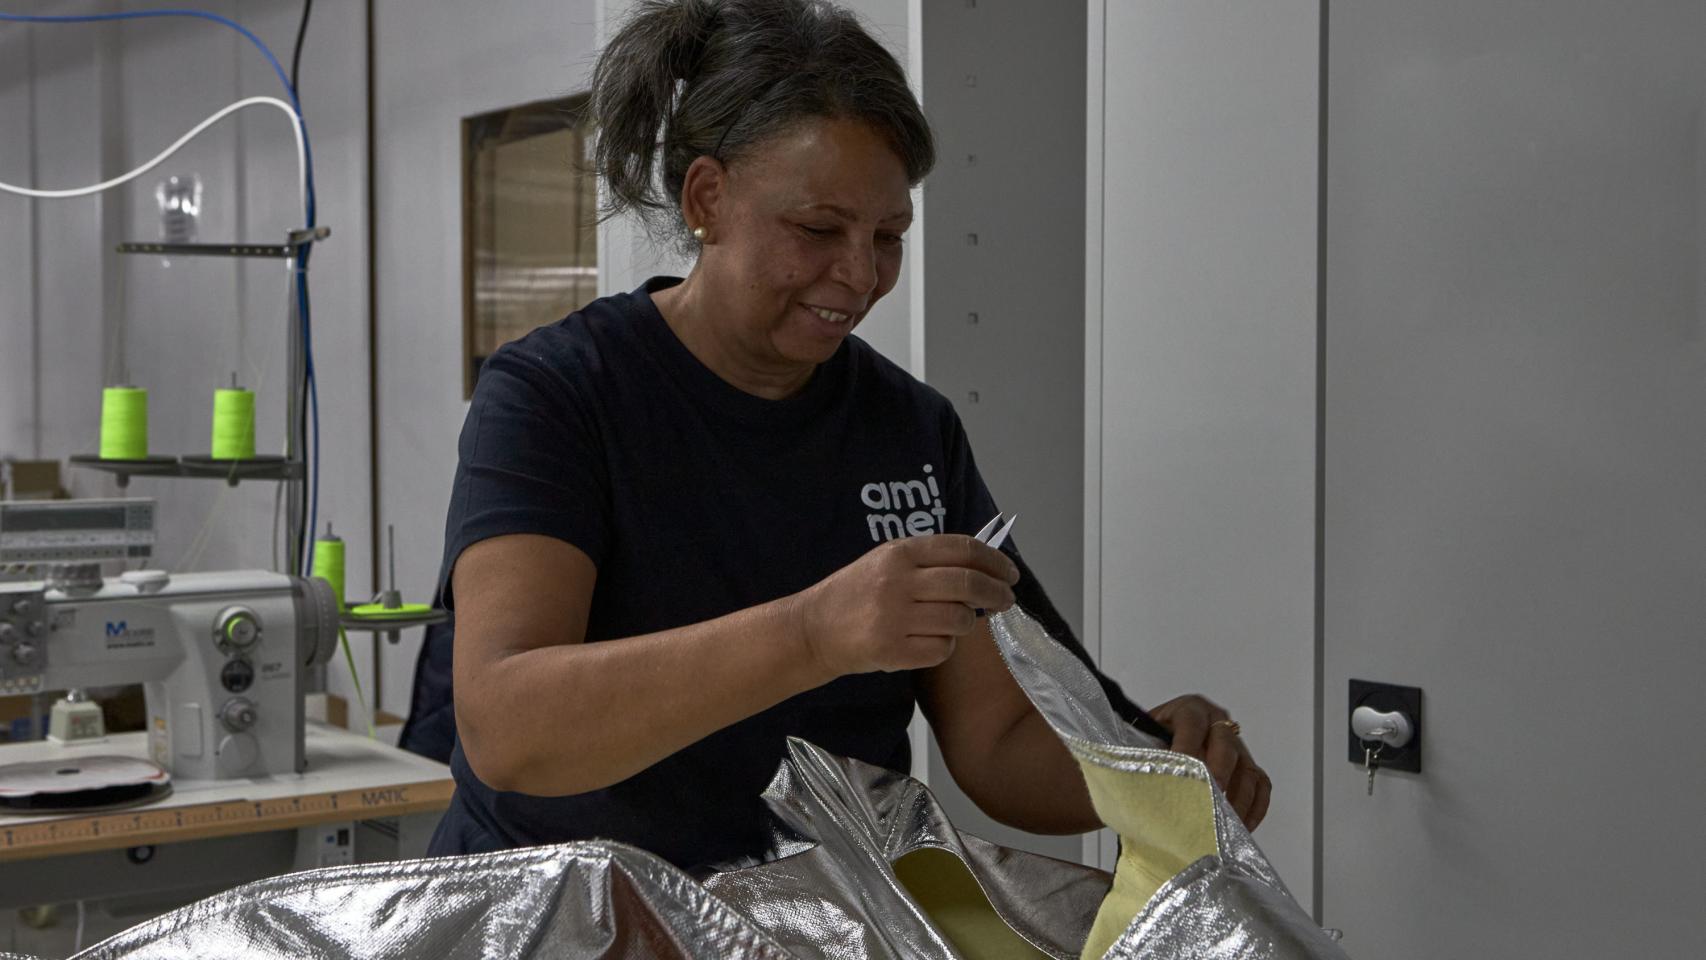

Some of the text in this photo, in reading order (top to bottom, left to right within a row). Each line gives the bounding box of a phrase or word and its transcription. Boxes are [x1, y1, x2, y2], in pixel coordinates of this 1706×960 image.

[860, 463, 940, 511] ami
[866, 498, 947, 543] met
[361, 786, 409, 805] MATIC
